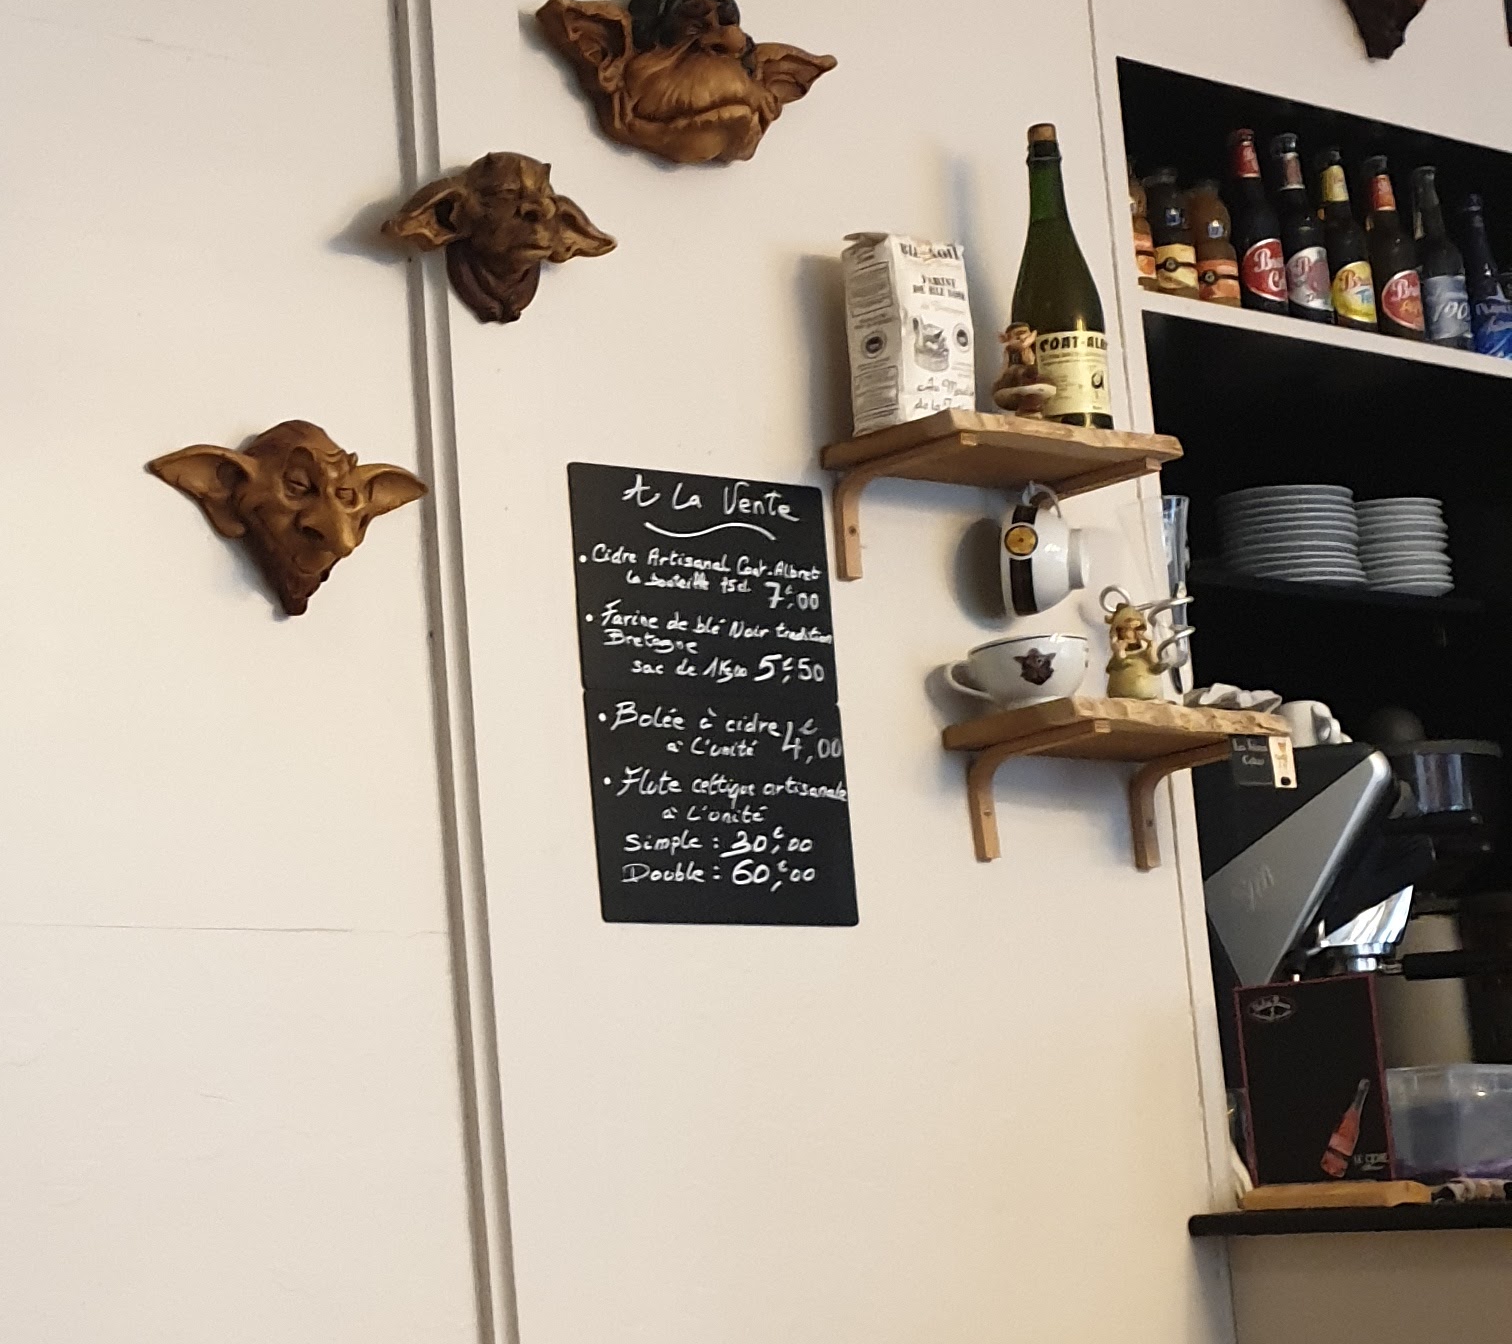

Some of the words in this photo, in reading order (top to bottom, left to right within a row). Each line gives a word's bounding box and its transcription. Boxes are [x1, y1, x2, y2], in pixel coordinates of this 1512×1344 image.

[672, 482, 702, 510] La
[723, 481, 800, 522] Vente
[592, 543, 637, 564] Cidre
[647, 547, 731, 572] Artisanal
[601, 598, 659, 627] Farine
[666, 611, 689, 631] de
[692, 615, 727, 635] blé
[728, 620, 770, 639] Noir
[603, 629, 699, 654] Bretagne
[631, 660, 665, 676] sac
[675, 658, 698, 677] de
[610, 701, 686, 731] Bolée
[699, 707, 718, 730] à
[725, 712, 783, 737] cidre
[623, 829, 704, 856] Simple
[621, 861, 705, 883] Double
